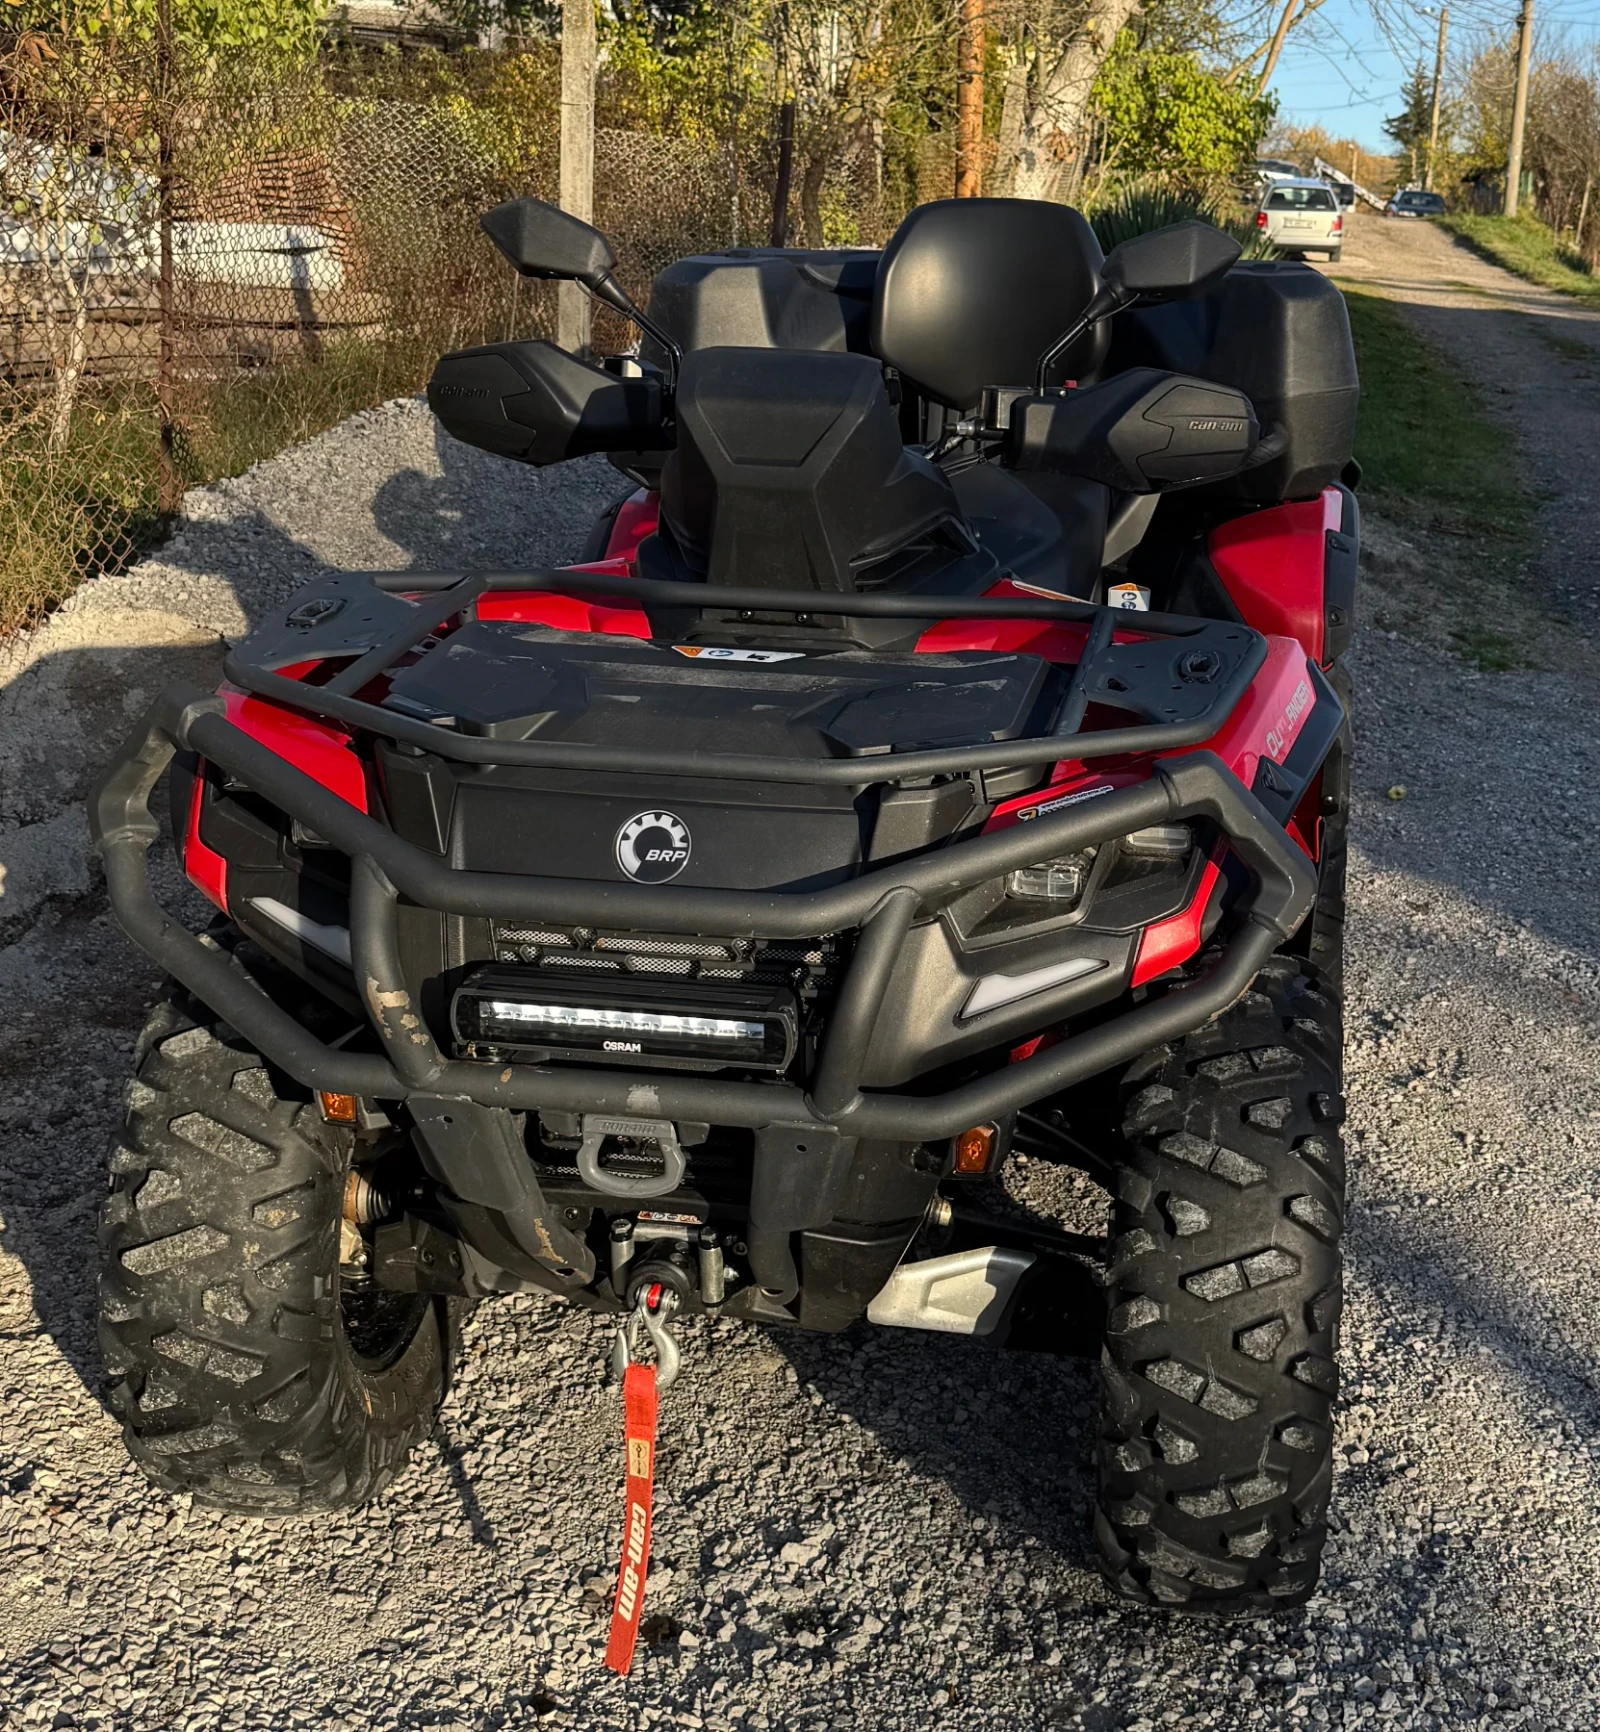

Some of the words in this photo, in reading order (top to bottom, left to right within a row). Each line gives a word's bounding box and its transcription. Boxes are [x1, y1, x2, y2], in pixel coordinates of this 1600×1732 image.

[1188, 420, 1244, 432] can-am
[644, 849, 687, 863] BRP
[602, 1040, 642, 1053] OSRAM
[618, 1501, 647, 1622] can-am
